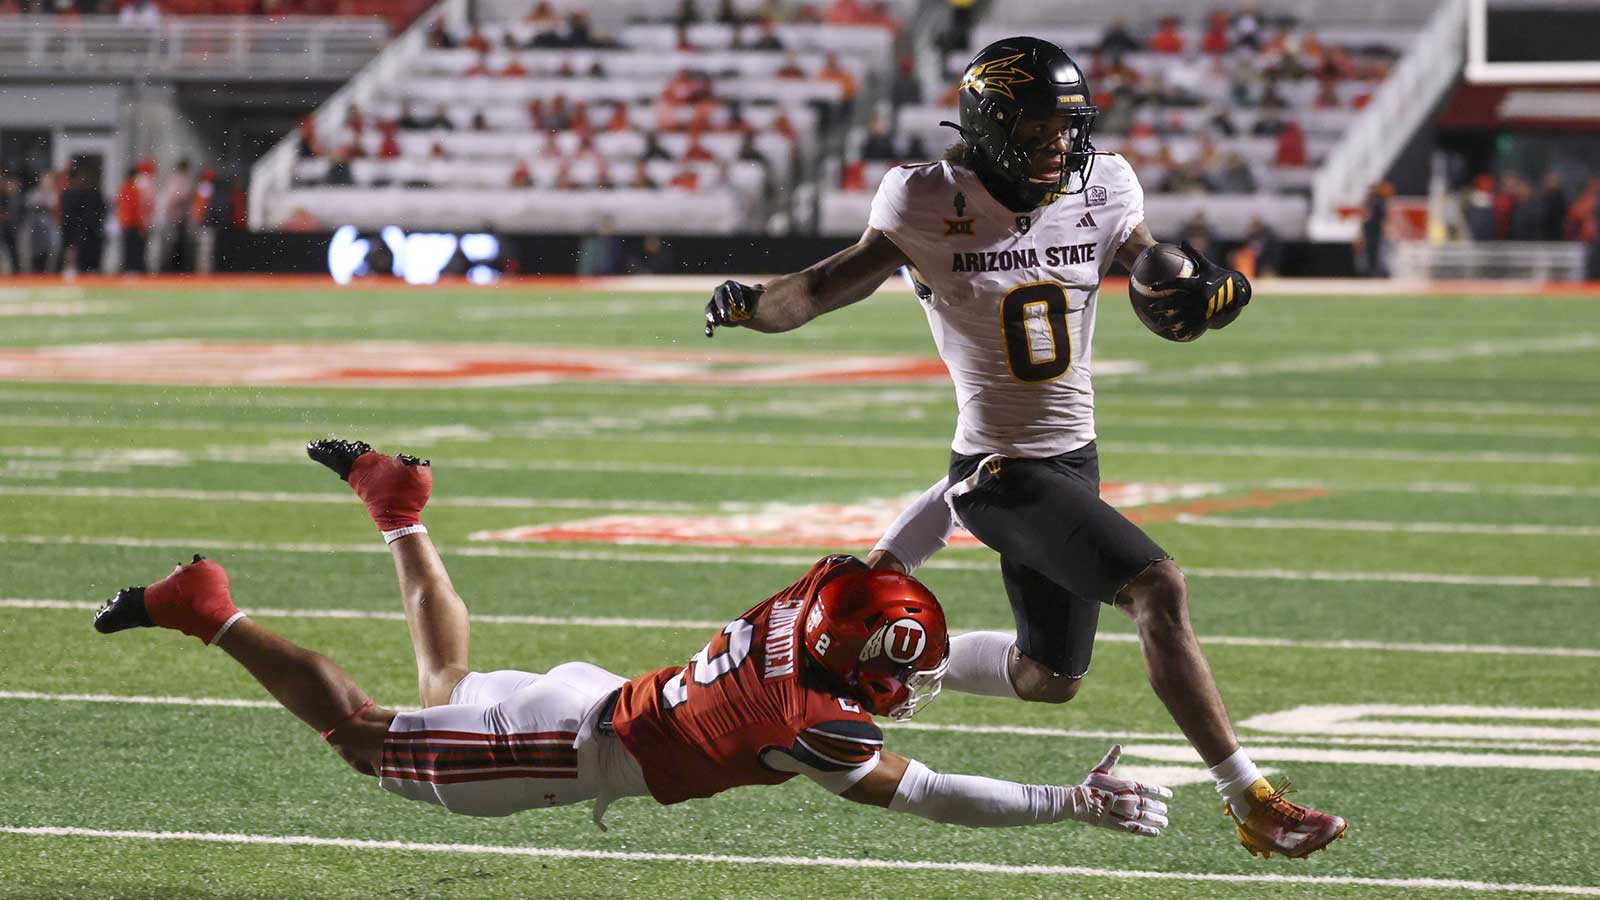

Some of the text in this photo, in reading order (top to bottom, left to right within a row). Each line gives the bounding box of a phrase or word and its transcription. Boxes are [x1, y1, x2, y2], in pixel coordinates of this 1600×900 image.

[952, 242, 1098, 273] ARIZONA STATE
[1001, 280, 1072, 384] 0
[764, 600, 805, 679] SNOWDEN
[814, 632, 831, 657] 2
[892, 626, 923, 659] U
